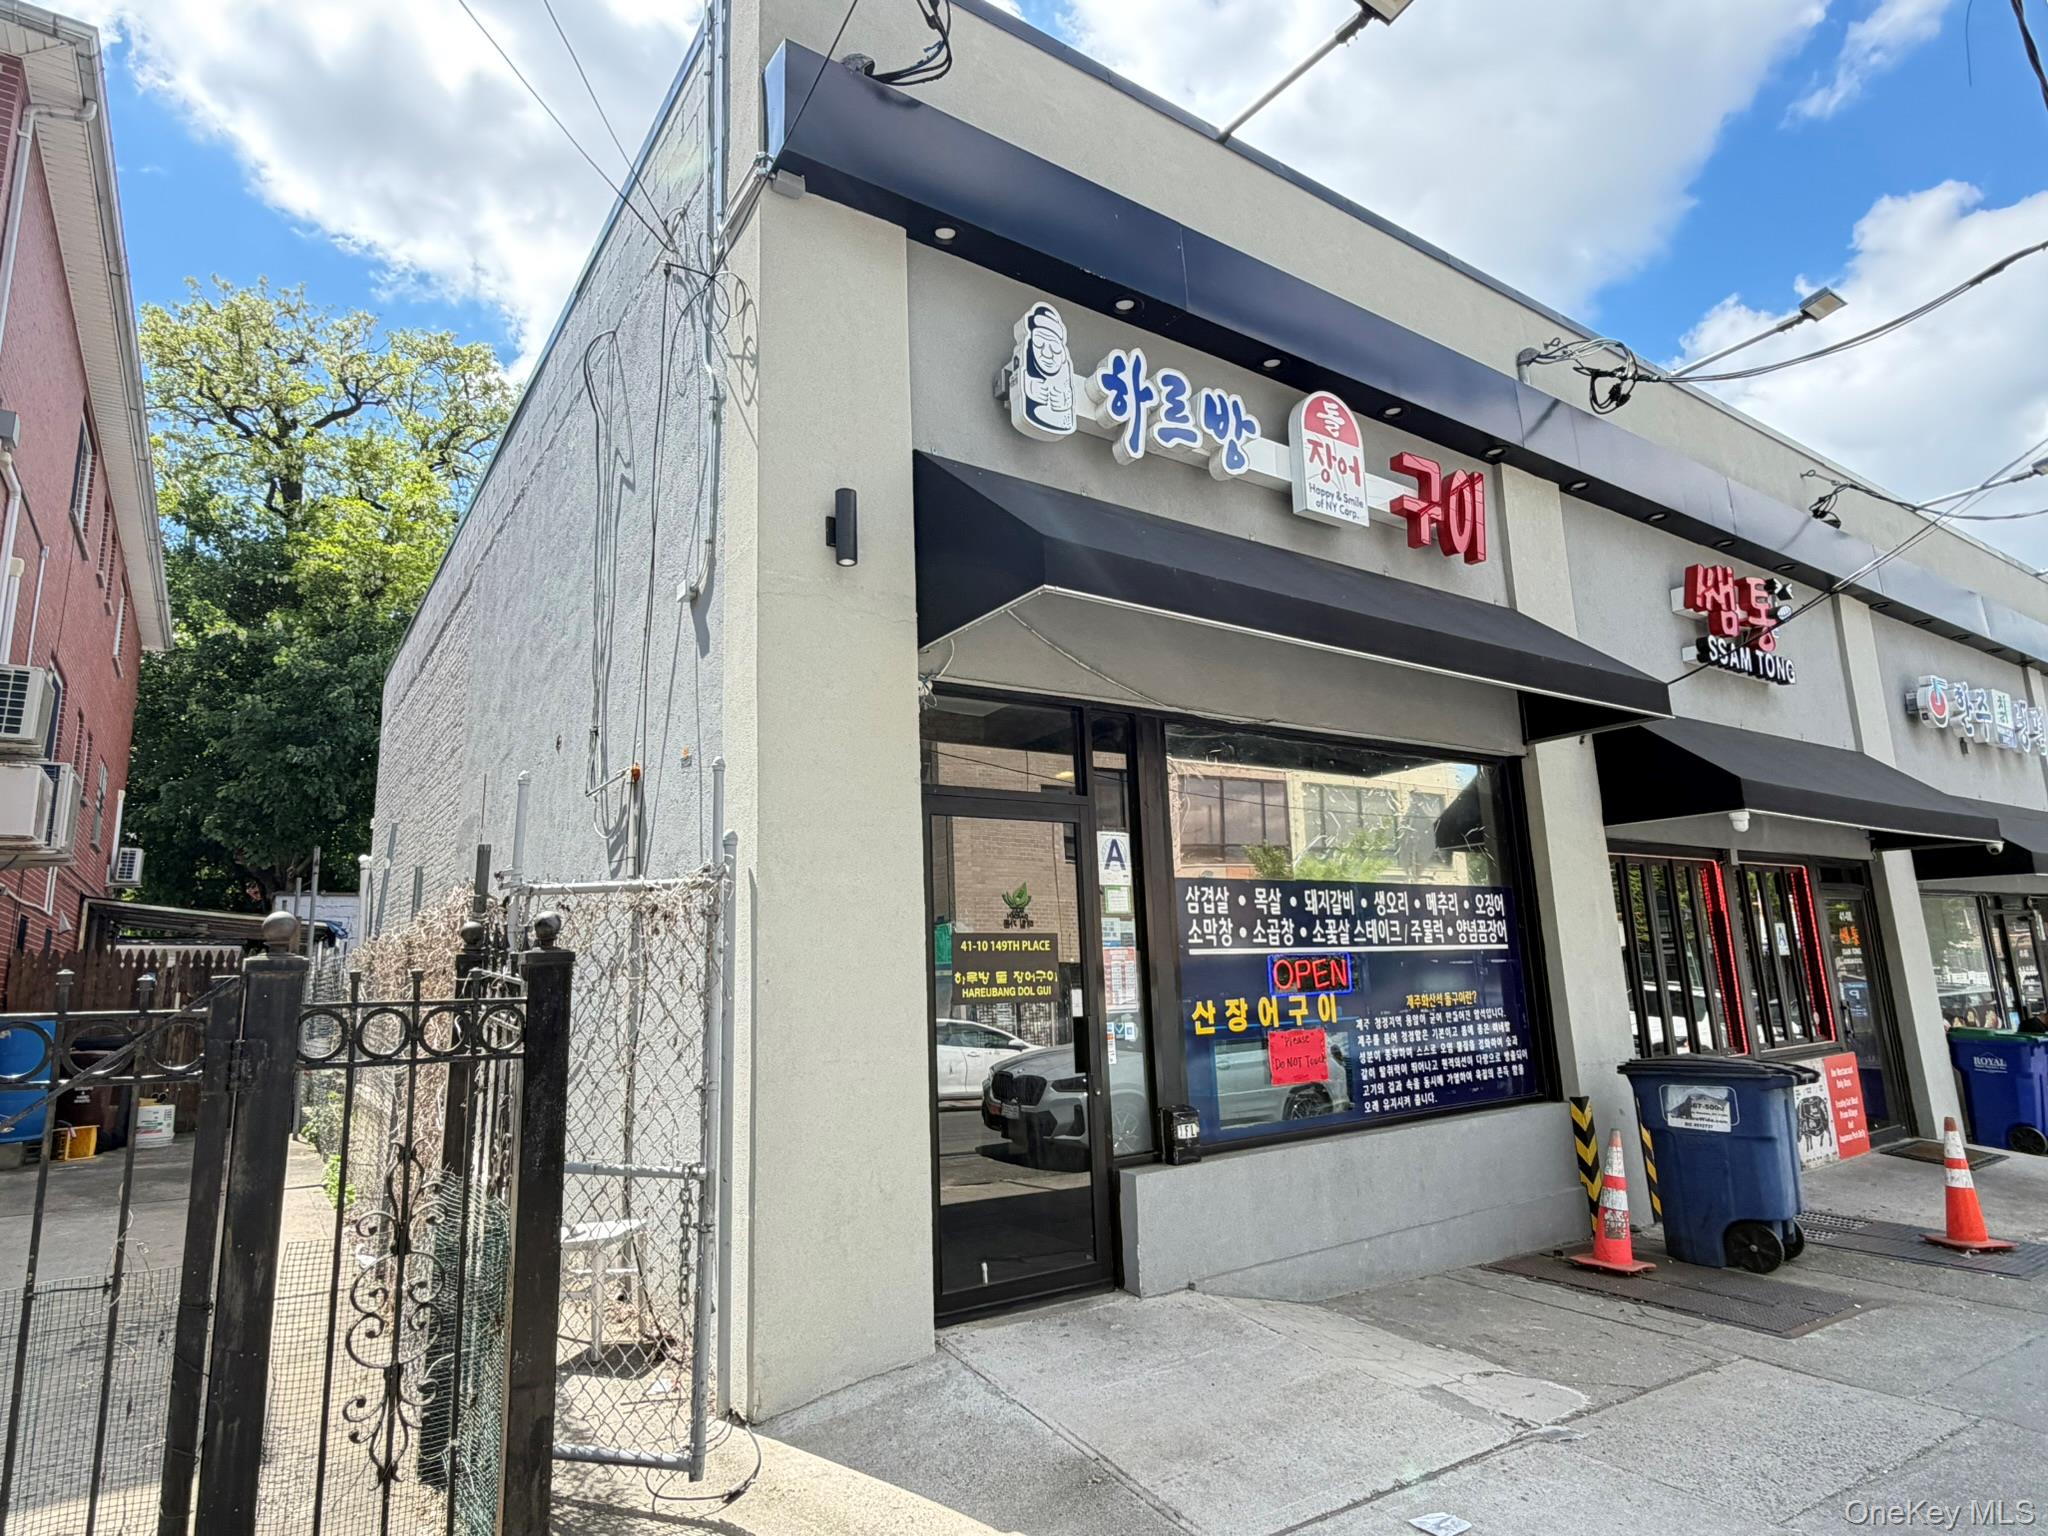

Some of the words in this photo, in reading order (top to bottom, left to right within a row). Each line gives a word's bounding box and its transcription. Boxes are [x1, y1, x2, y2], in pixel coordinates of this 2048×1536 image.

[1100, 349, 1260, 473] 하르방
[1306, 438, 1361, 487] 장어
[1308, 482, 1335, 500] Happy
[1343, 493, 1364, 508] Smile
[1316, 499, 1325, 508] of
[1325, 501, 1338, 513] NY
[1340, 505, 1360, 519] Corp.
[1390, 452, 1486, 565] 구이
[1708, 635, 1753, 672] SSAM
[1755, 649, 1797, 684] TONG
[1104, 839, 1127, 870] A
[1185, 885, 1230, 914] 삼겹살
[1254, 887, 1282, 915] 목살
[1304, 888, 1355, 916] 돼지갈비
[1373, 890, 1409, 916] 생오리
[1425, 891, 1459, 916] 메추리
[1475, 893, 1505, 917] 오징어
[960, 941, 988, 952] 41-10
[990, 940, 1020, 952] 149TH
[1022, 940, 1051, 951] PLACE
[1188, 917, 1233, 947] 소막창
[1252, 917, 1295, 946] 소곱창
[1312, 918, 1350, 945] 소꽃살
[1456, 919, 1508, 944] 양념꼼장어
[1273, 959, 1348, 989] OPEN
[962, 987, 1015, 998] HAREUBANG
[1018, 986, 1035, 996] DOL
[1037, 986, 1052, 995] GUI
[1275, 1058, 1286, 1070] Do
[1287, 1056, 1302, 1068] NOT
[1973, 1055, 2007, 1067] ROYAL
